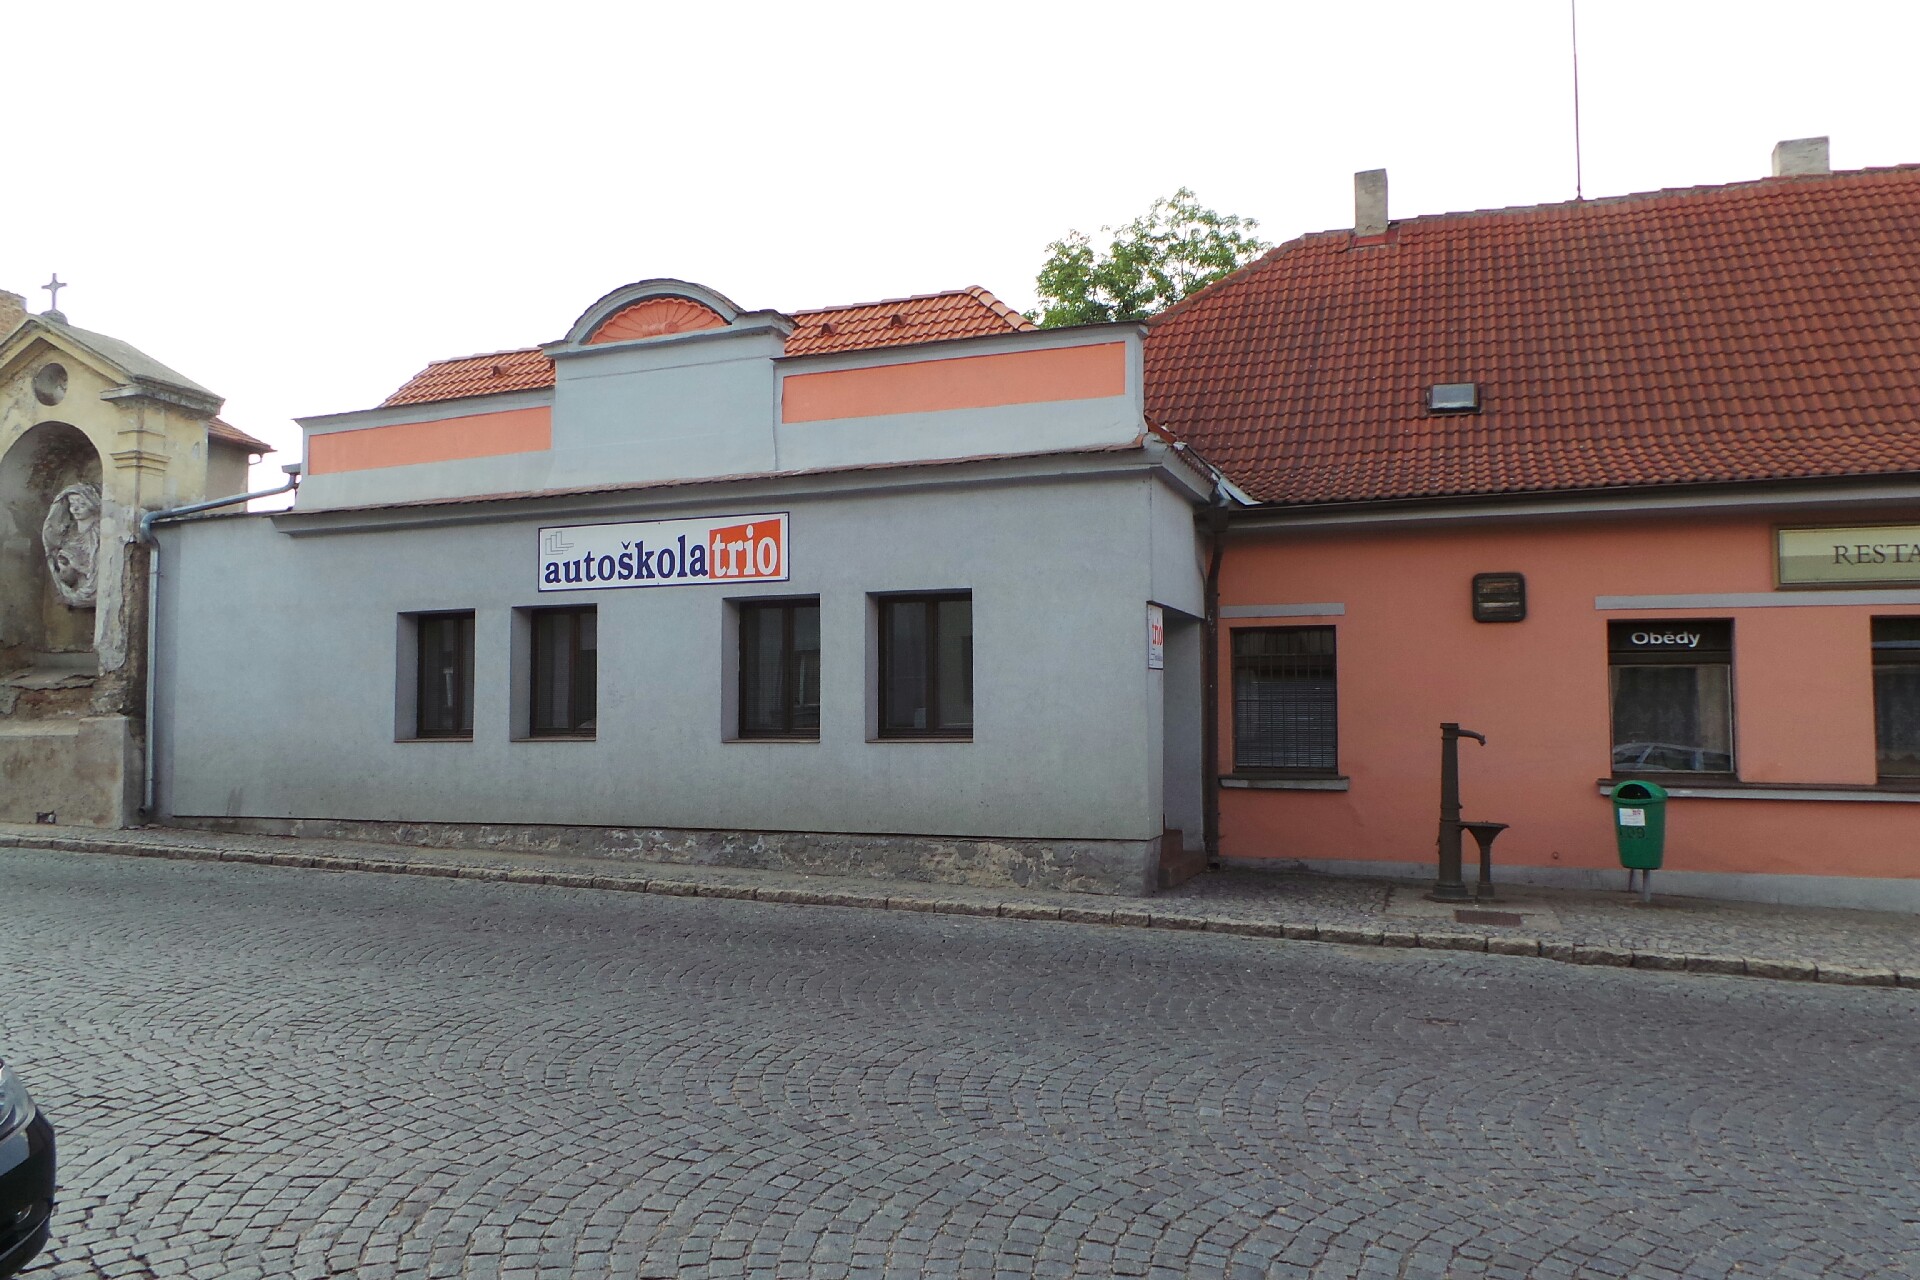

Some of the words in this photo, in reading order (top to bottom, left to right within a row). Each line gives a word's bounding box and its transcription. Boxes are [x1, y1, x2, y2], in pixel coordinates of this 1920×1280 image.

[544, 534, 708, 584] autoškola
[711, 524, 778, 577] trio
[1631, 631, 1701, 647] Obědy
